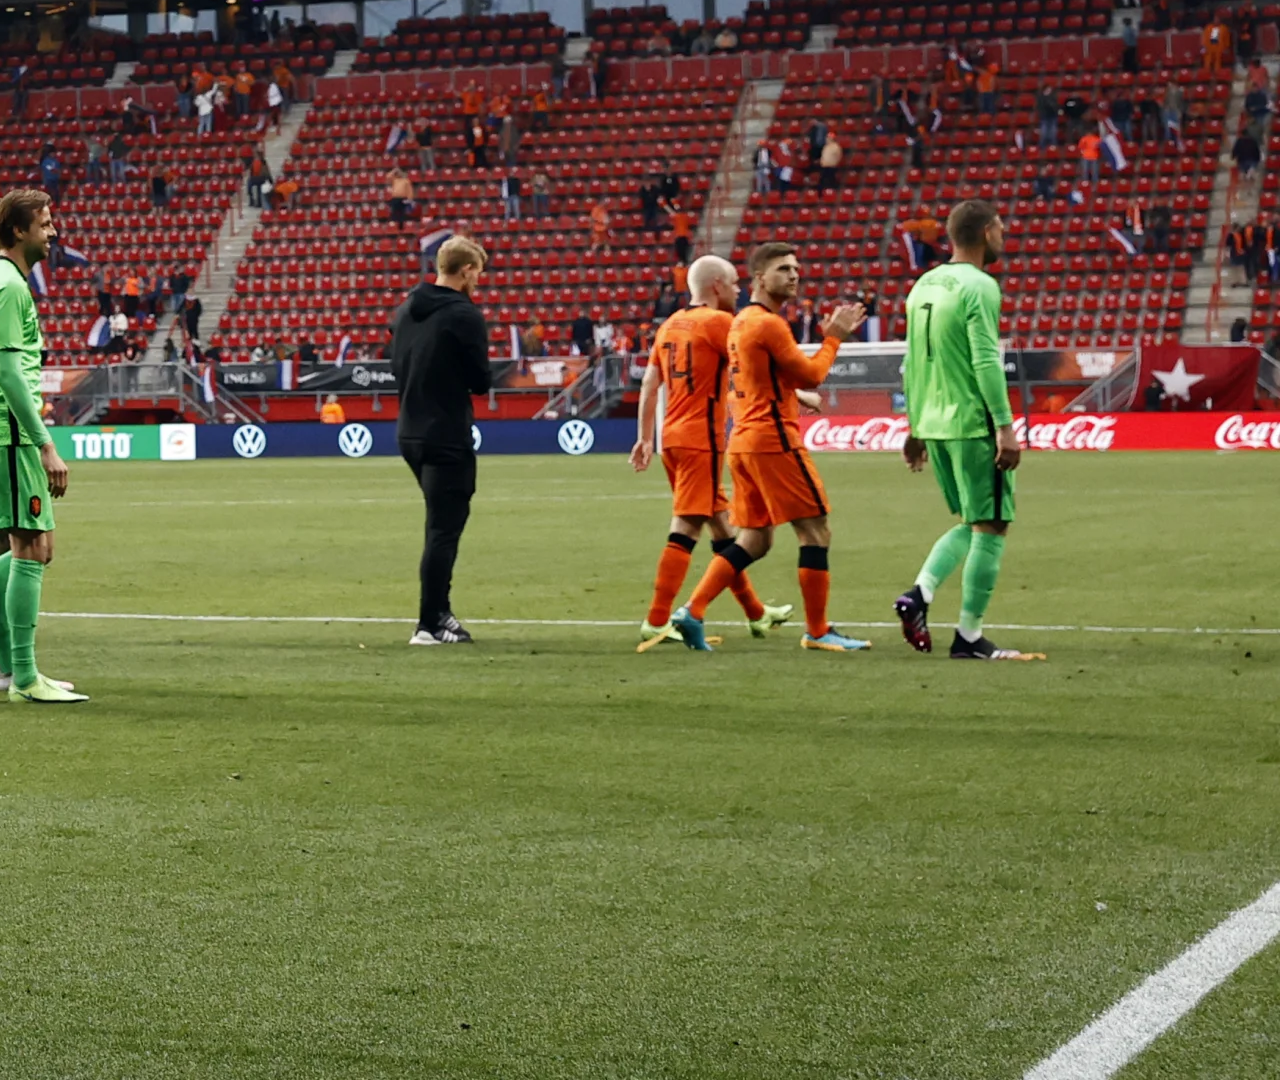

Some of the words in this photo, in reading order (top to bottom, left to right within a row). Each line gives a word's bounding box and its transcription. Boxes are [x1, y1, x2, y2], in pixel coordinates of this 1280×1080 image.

[920, 302, 933, 362] 1
[662, 341, 694, 393] 14
[71, 432, 131, 459] TOTO
